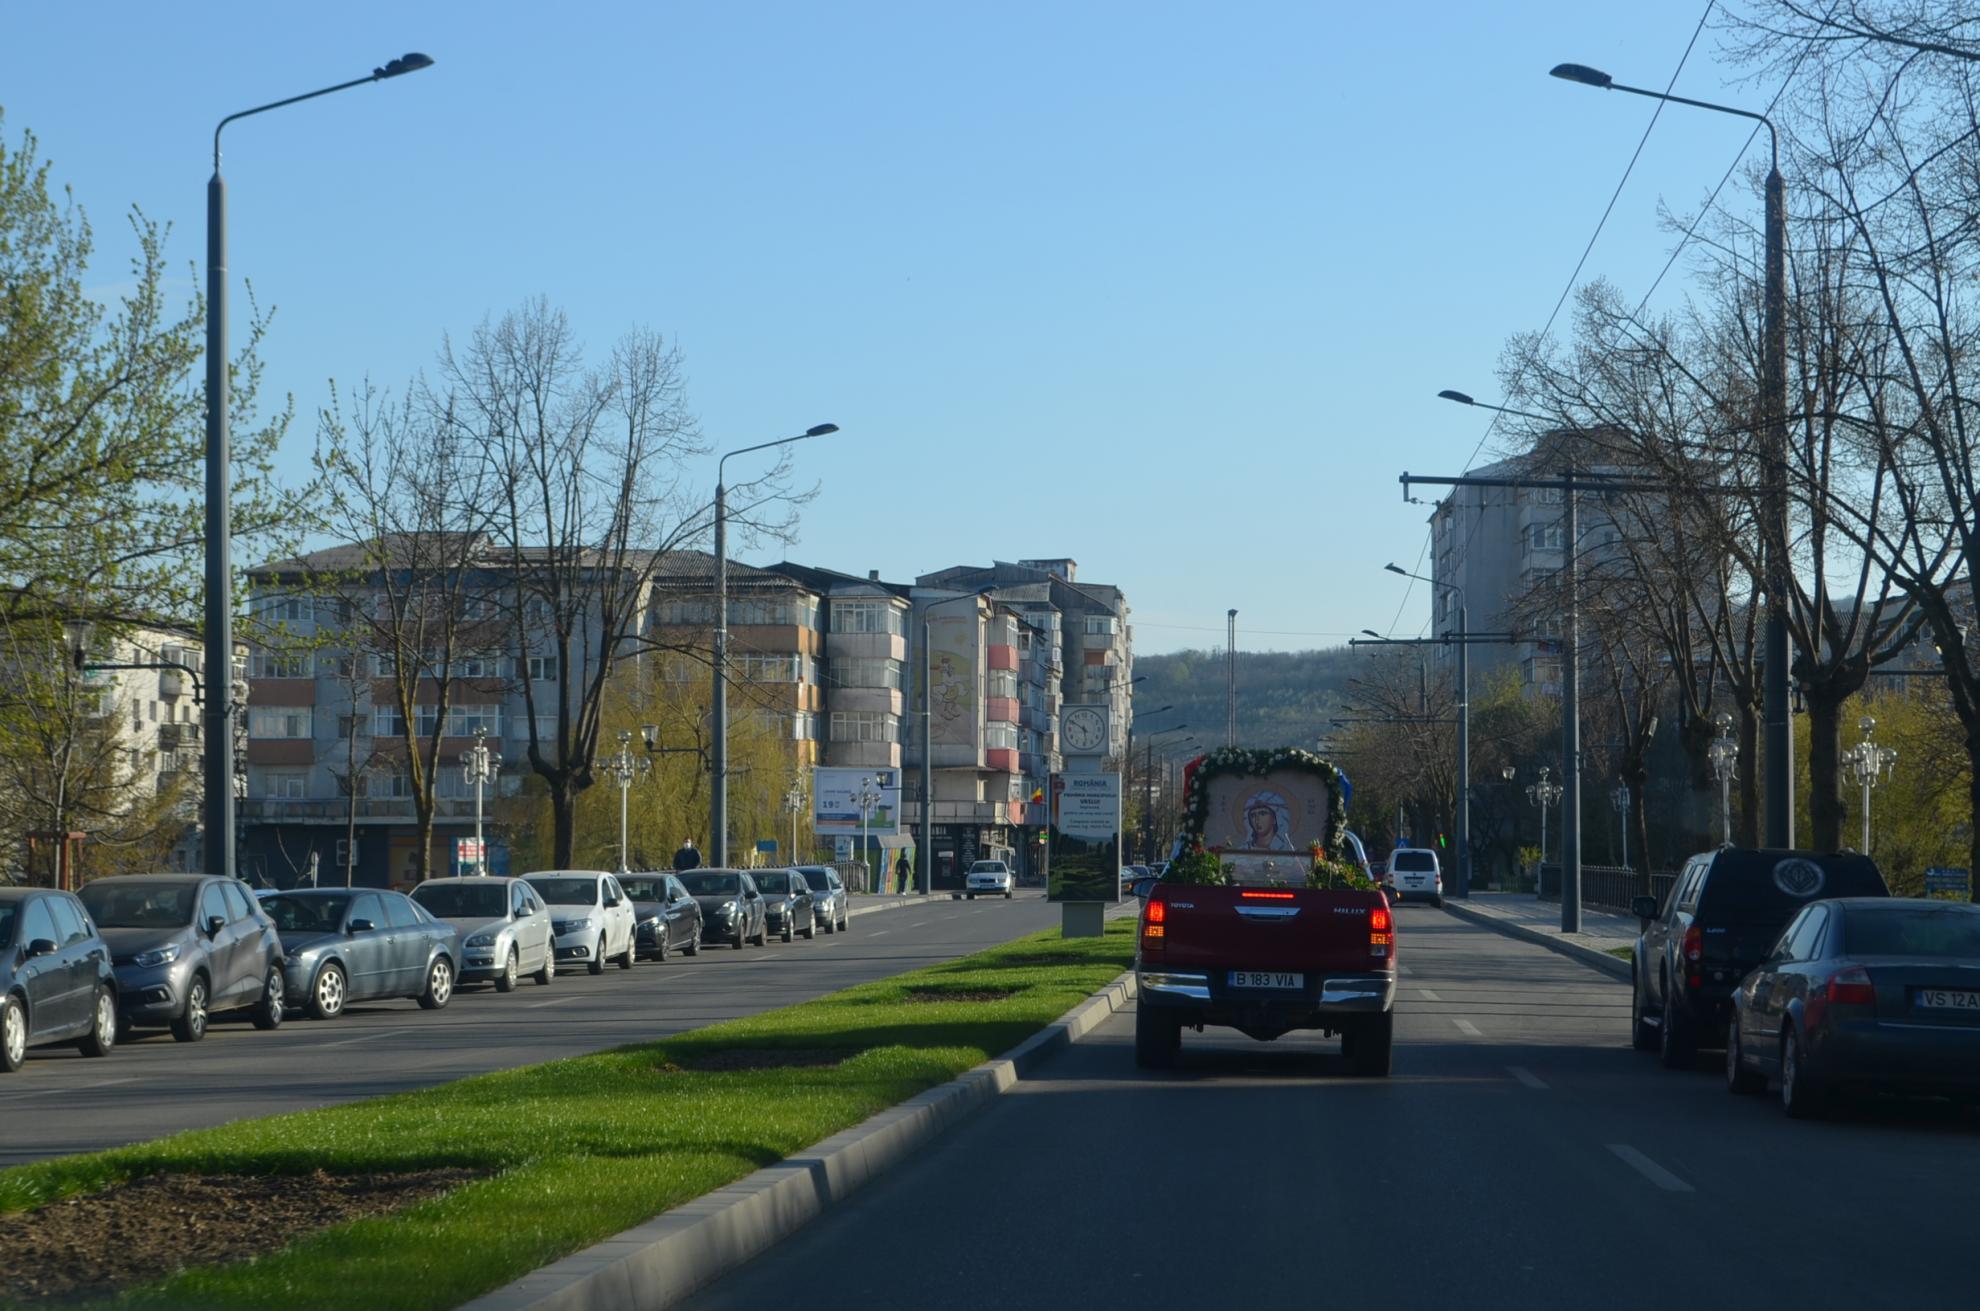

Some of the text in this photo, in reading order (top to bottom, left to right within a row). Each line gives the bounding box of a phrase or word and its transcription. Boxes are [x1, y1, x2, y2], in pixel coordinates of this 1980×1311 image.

[1170, 902, 1194, 910] TOYOTA
[1236, 973, 1295, 987] B 183 VIA
[1924, 991, 1980, 1009] VS 12 A
